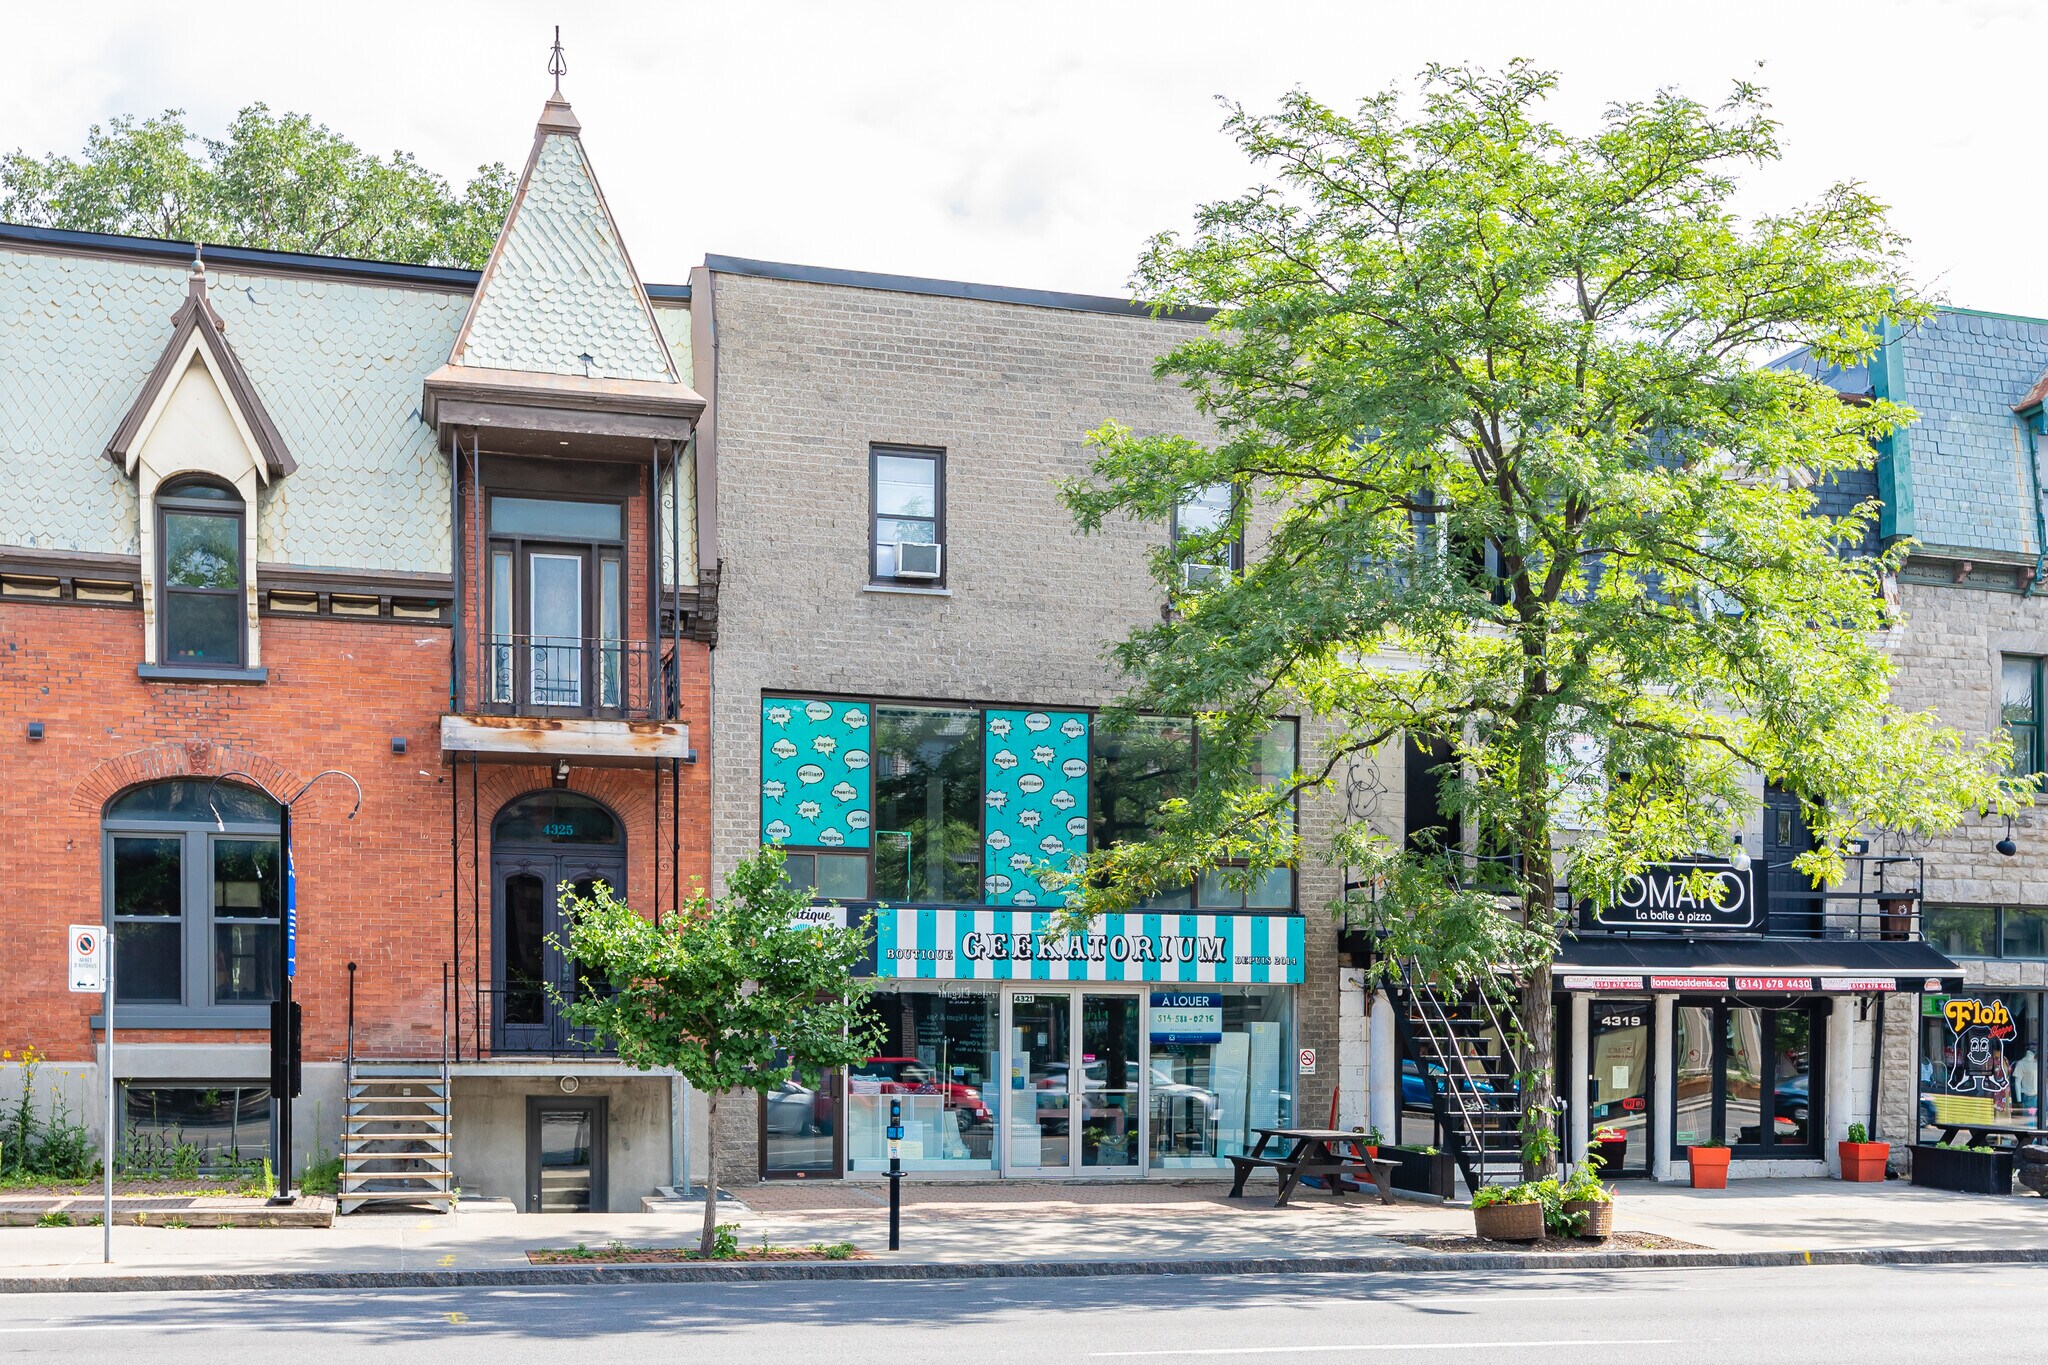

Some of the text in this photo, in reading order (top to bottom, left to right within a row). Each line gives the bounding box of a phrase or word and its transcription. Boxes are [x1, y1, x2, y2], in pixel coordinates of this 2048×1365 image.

[846, 715, 866, 723] inspiré
[773, 746, 795, 754] magique
[834, 788, 856, 796] cheerful
[802, 806, 816, 814] geek
[542, 824, 574, 836] 4325
[768, 826, 787, 834] coloré
[820, 834, 843, 842] magique
[1611, 871, 1745, 912] OMAO
[785, 908, 831, 924] outique
[1636, 909, 1712, 923] La boîte à pizza
[961, 930, 1228, 965] GEEKATORIUM
[886, 948, 954, 961] BOUTIQUE
[1234, 955, 1298, 967] DEPUIS 2014
[1652, 977, 1728, 988] tomatostdenis.ca
[1736, 978, 1810, 990] (514) 678 4430
[1014, 995, 1033, 1003] 4321
[1162, 993, 1210, 1007] À LOUER
[1601, 1016, 1641, 1026] 4319
[1945, 1001, 2009, 1032] Floh
